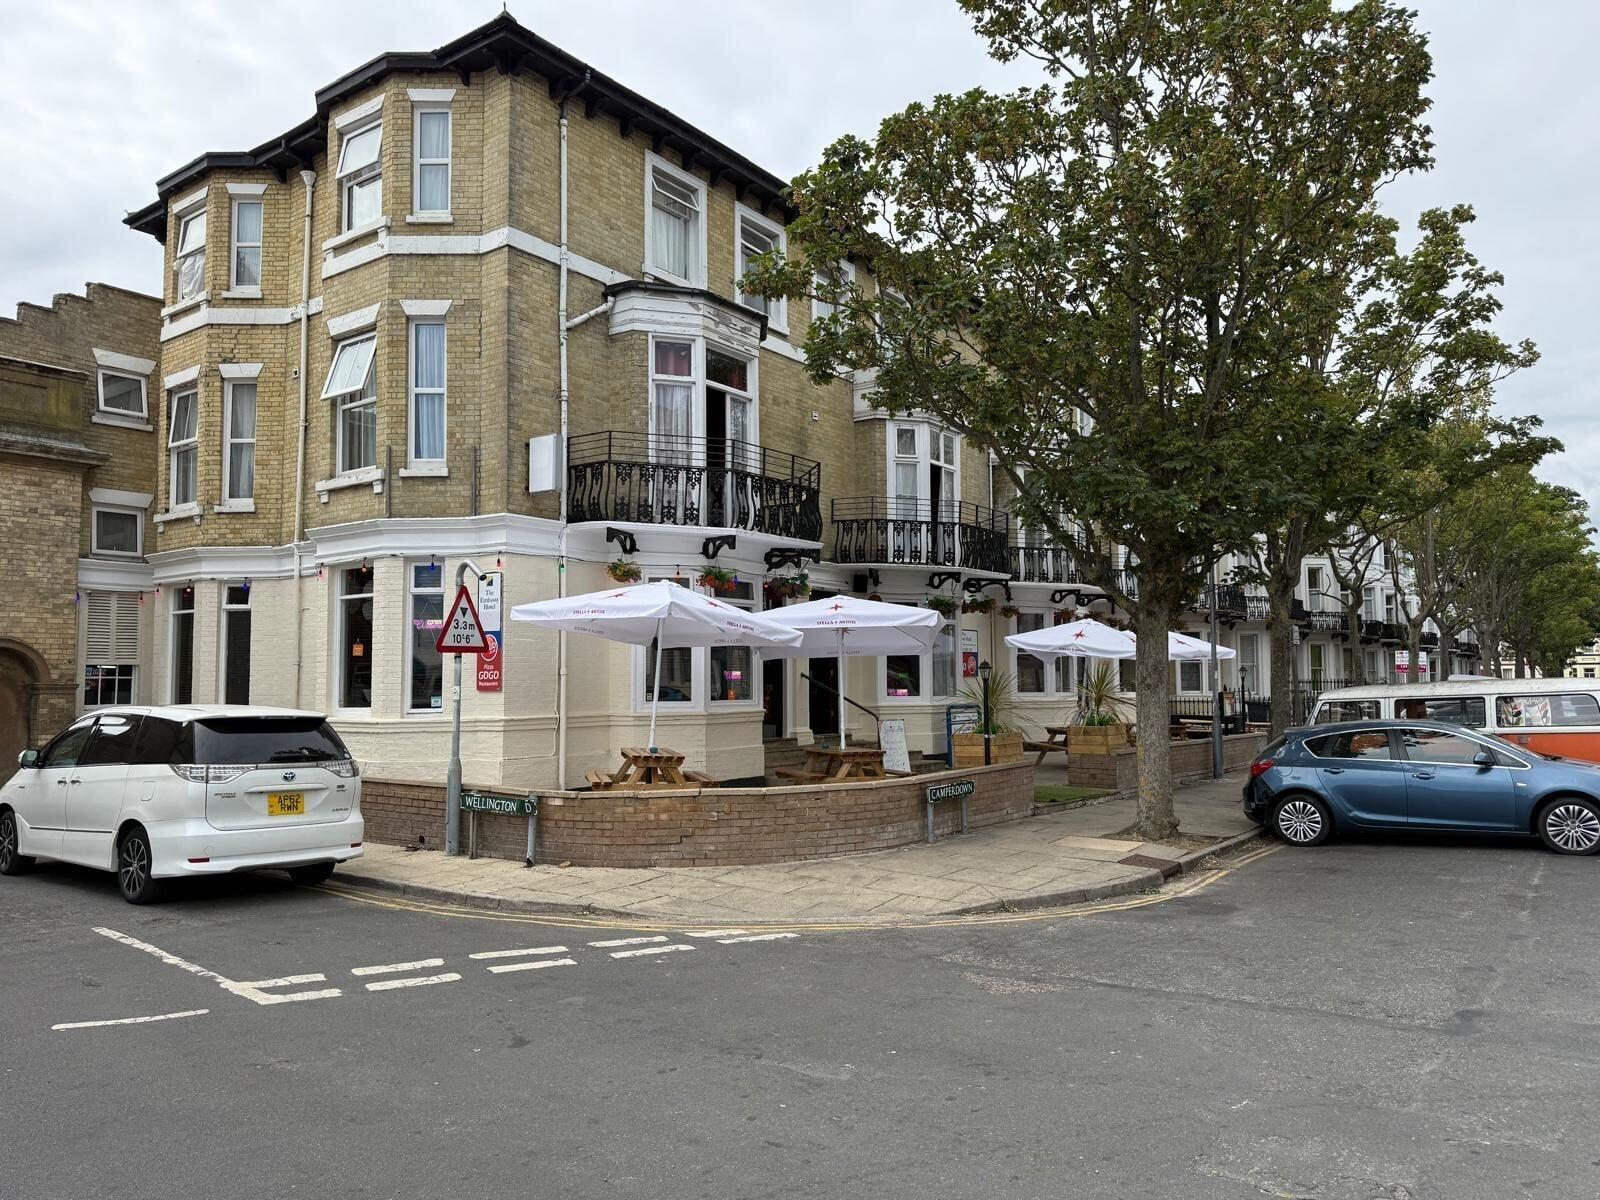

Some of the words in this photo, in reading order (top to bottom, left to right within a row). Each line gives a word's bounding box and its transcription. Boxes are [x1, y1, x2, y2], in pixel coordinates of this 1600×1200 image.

[478, 670, 499, 680] GOGO
[931, 782, 973, 800] CAMPERDOWN
[277, 794, 301, 804] AP62
[465, 796, 517, 812] WELLINGTON
[280, 803, 298, 812] RWN
